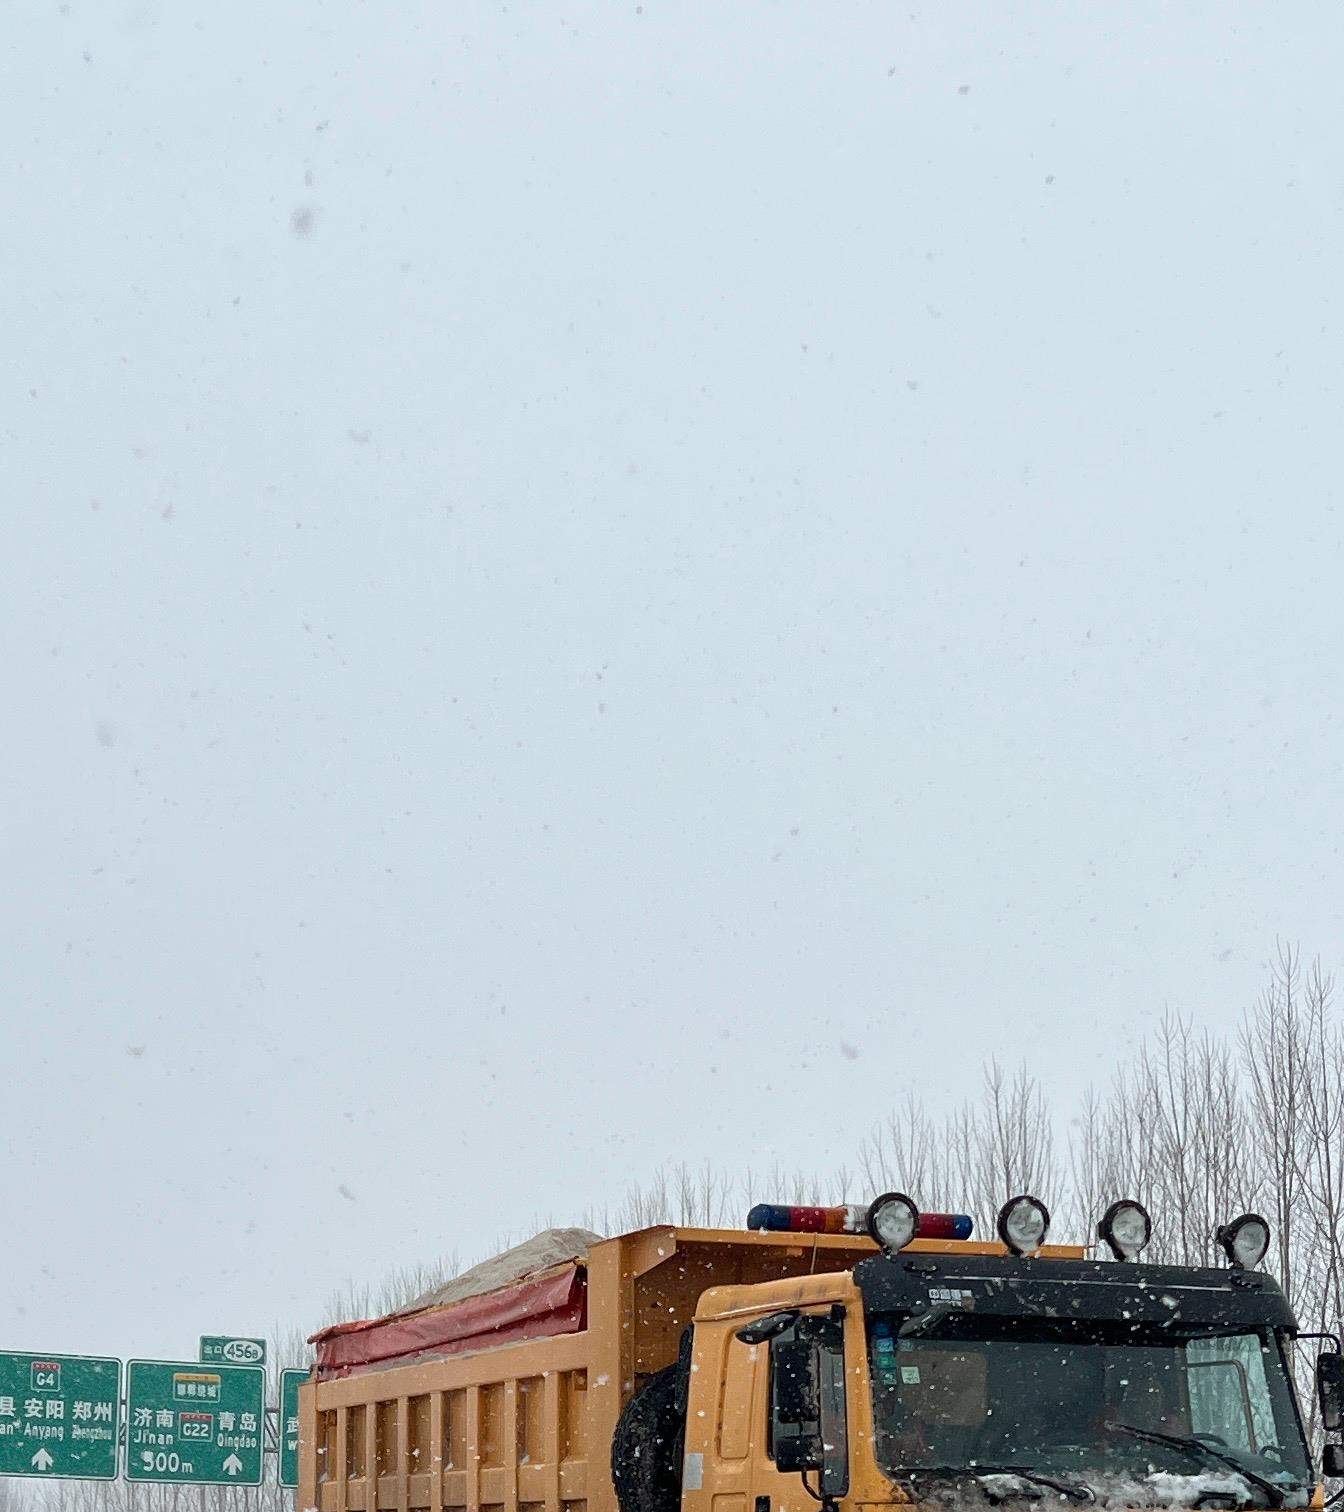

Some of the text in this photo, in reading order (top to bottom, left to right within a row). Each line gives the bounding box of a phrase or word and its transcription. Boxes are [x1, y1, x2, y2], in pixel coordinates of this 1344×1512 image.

[203, 1344, 222, 1354] 出口
[36, 1372, 55, 1386] G4
[23, 1398, 65, 1419] 安阳
[72, 1401, 113, 1422] 郑州
[133, 1407, 257, 1432] 济南 青岛
[23, 1422, 65, 1441] Anyang
[182, 1423, 209, 1437] G22
[217, 1433, 257, 1450] Qingdao
